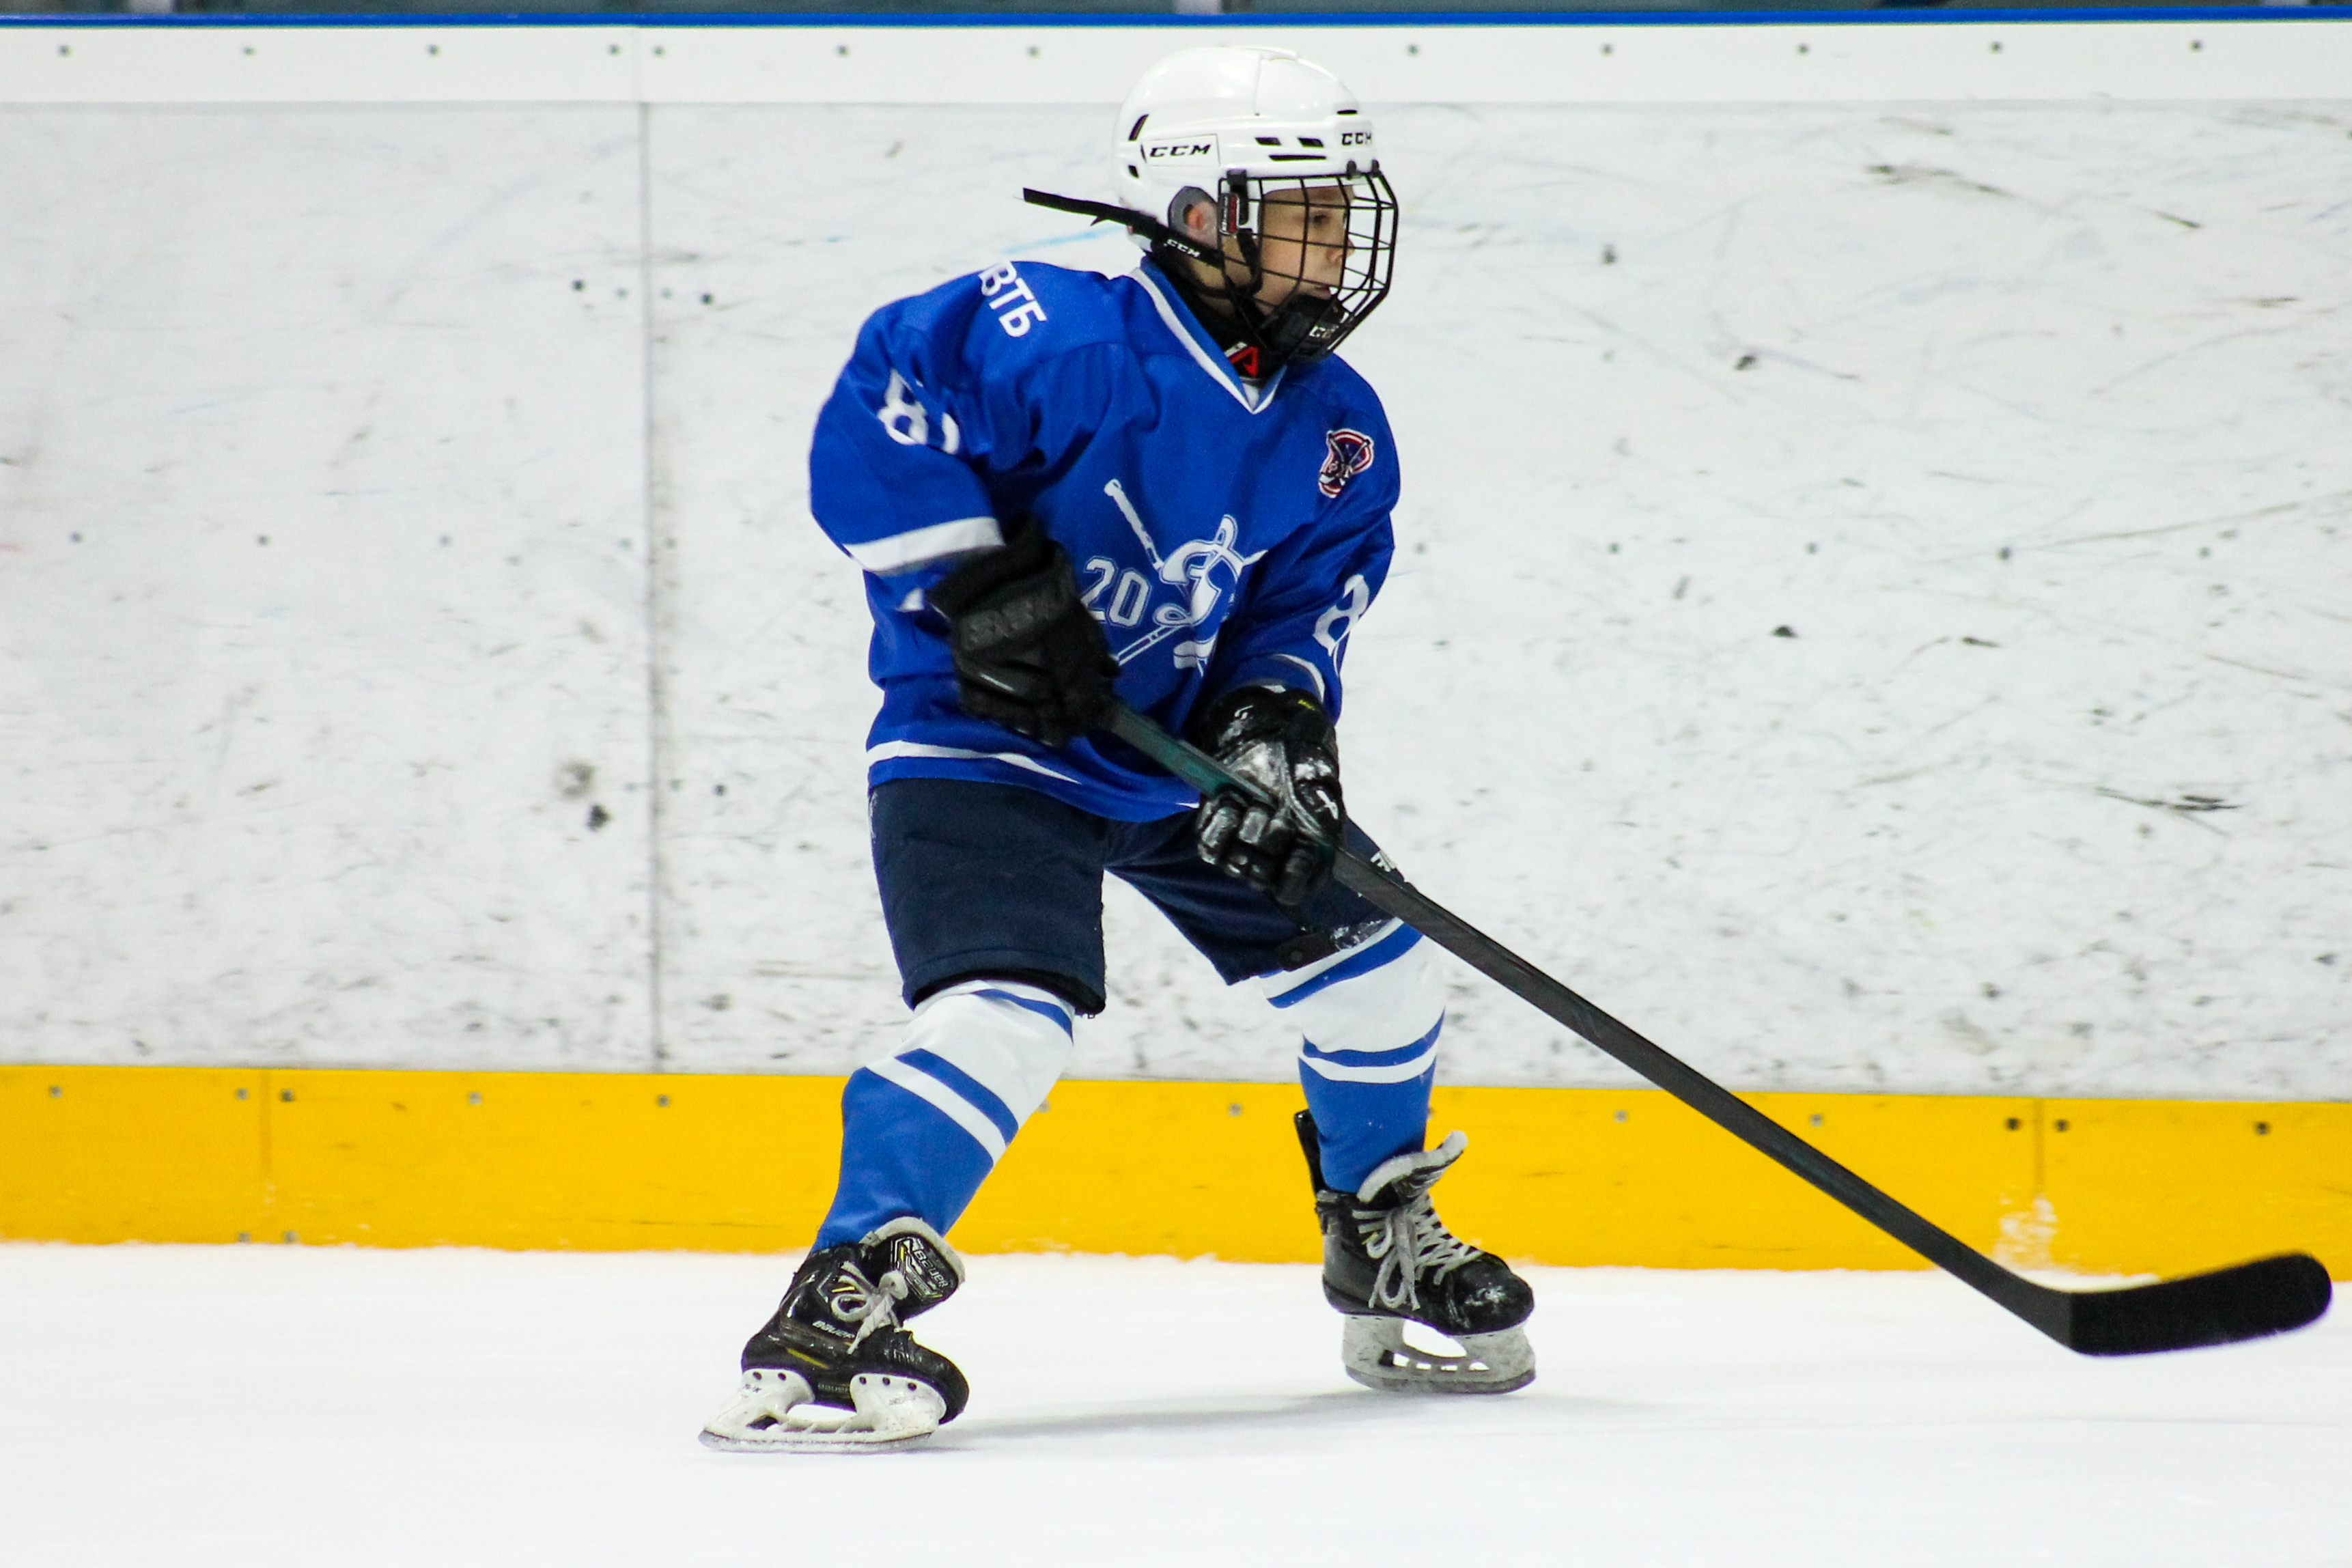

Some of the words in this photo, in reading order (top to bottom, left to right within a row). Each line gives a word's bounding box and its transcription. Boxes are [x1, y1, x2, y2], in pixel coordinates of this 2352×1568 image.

[1150, 144, 1212, 158] CCM
[1166, 238, 1201, 257] CCM
[1080, 555, 1152, 629] 20
